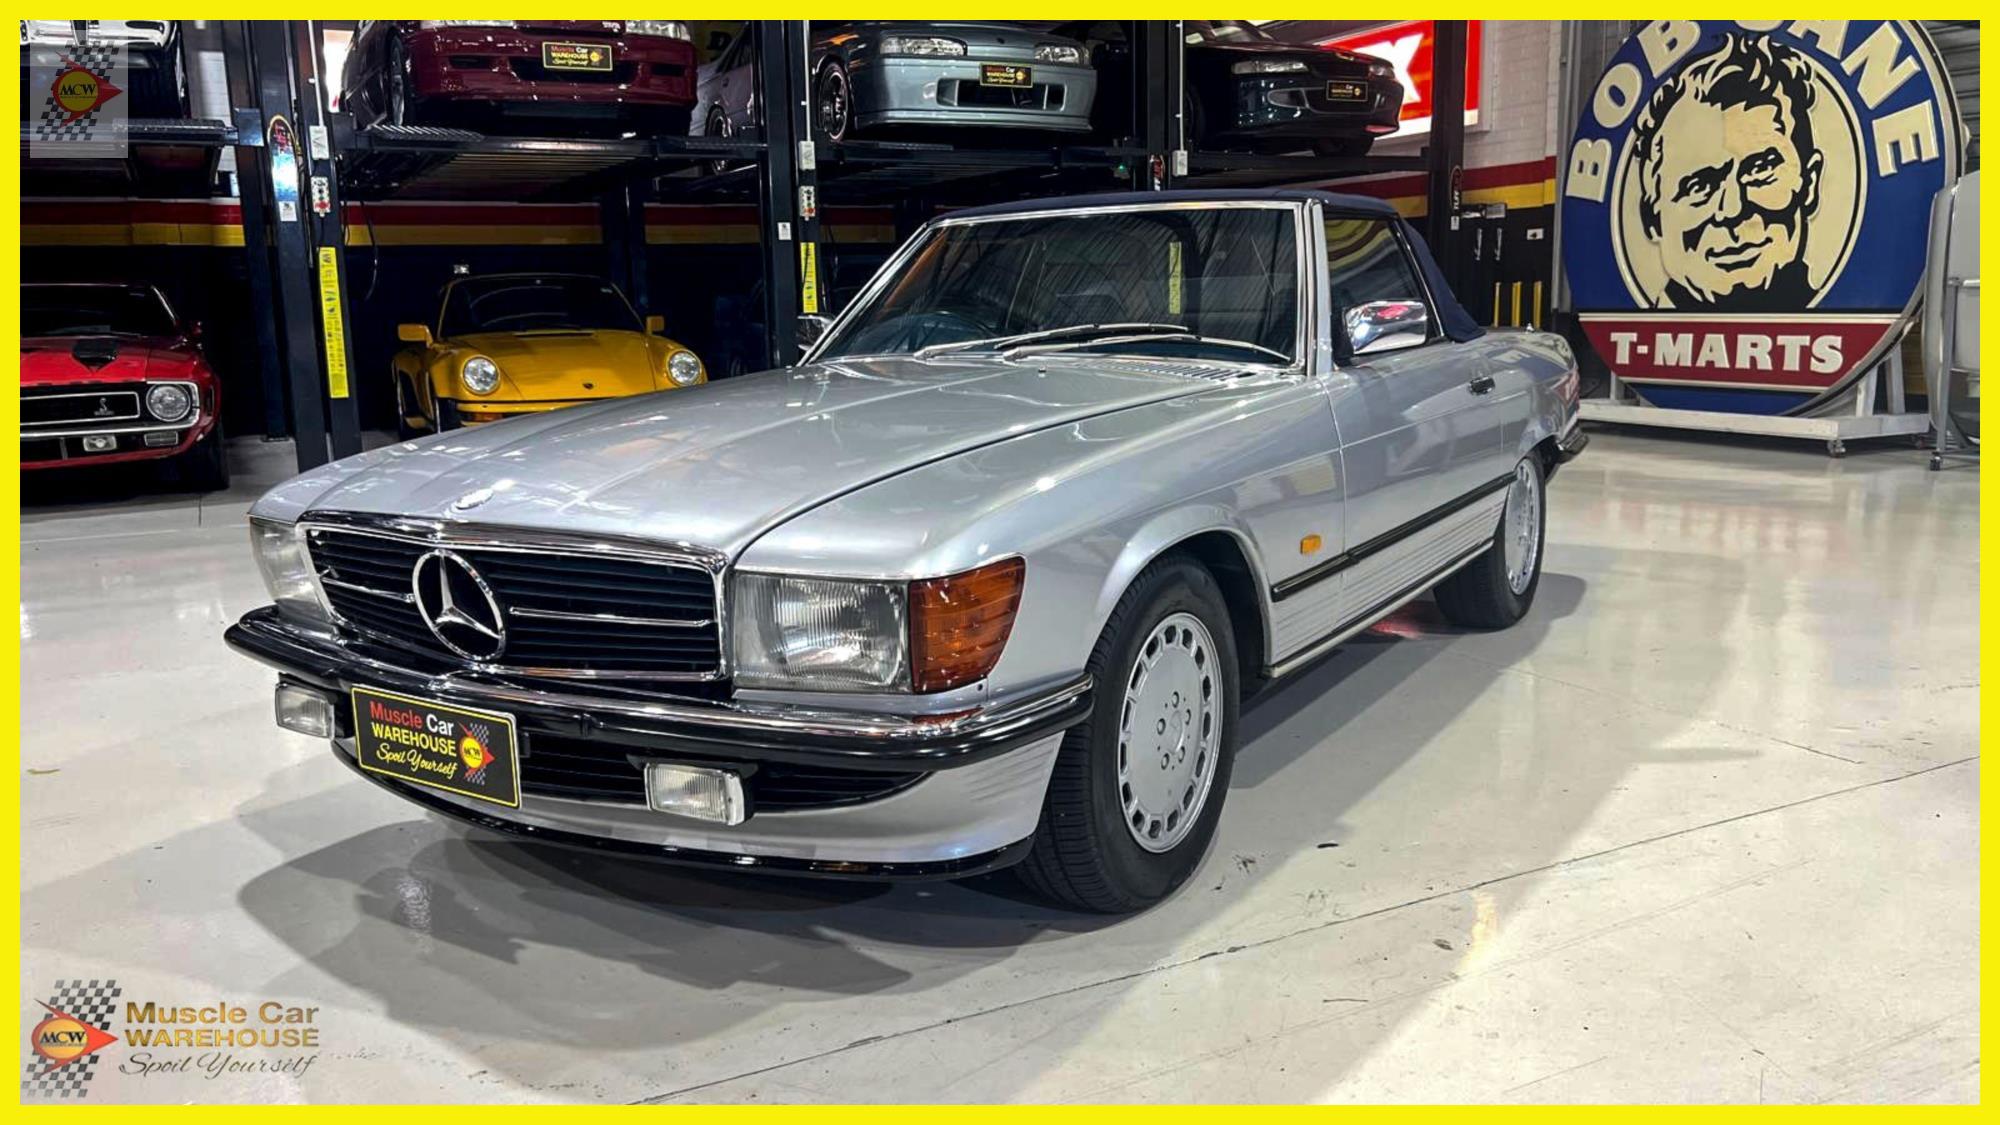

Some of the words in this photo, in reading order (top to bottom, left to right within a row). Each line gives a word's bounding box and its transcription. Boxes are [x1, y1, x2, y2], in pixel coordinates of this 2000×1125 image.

[1566, 20, 1701, 203] BOB
[1732, 20, 1940, 178] ANE
[1609, 331, 1845, 375] T-MARTS
[369, 700, 423, 729] Muscle
[426, 713, 455, 737] Car
[371, 721, 458, 757] WAREHOUSE
[376, 742, 406, 764] Spoil
[406, 749, 459, 780] Yourself
